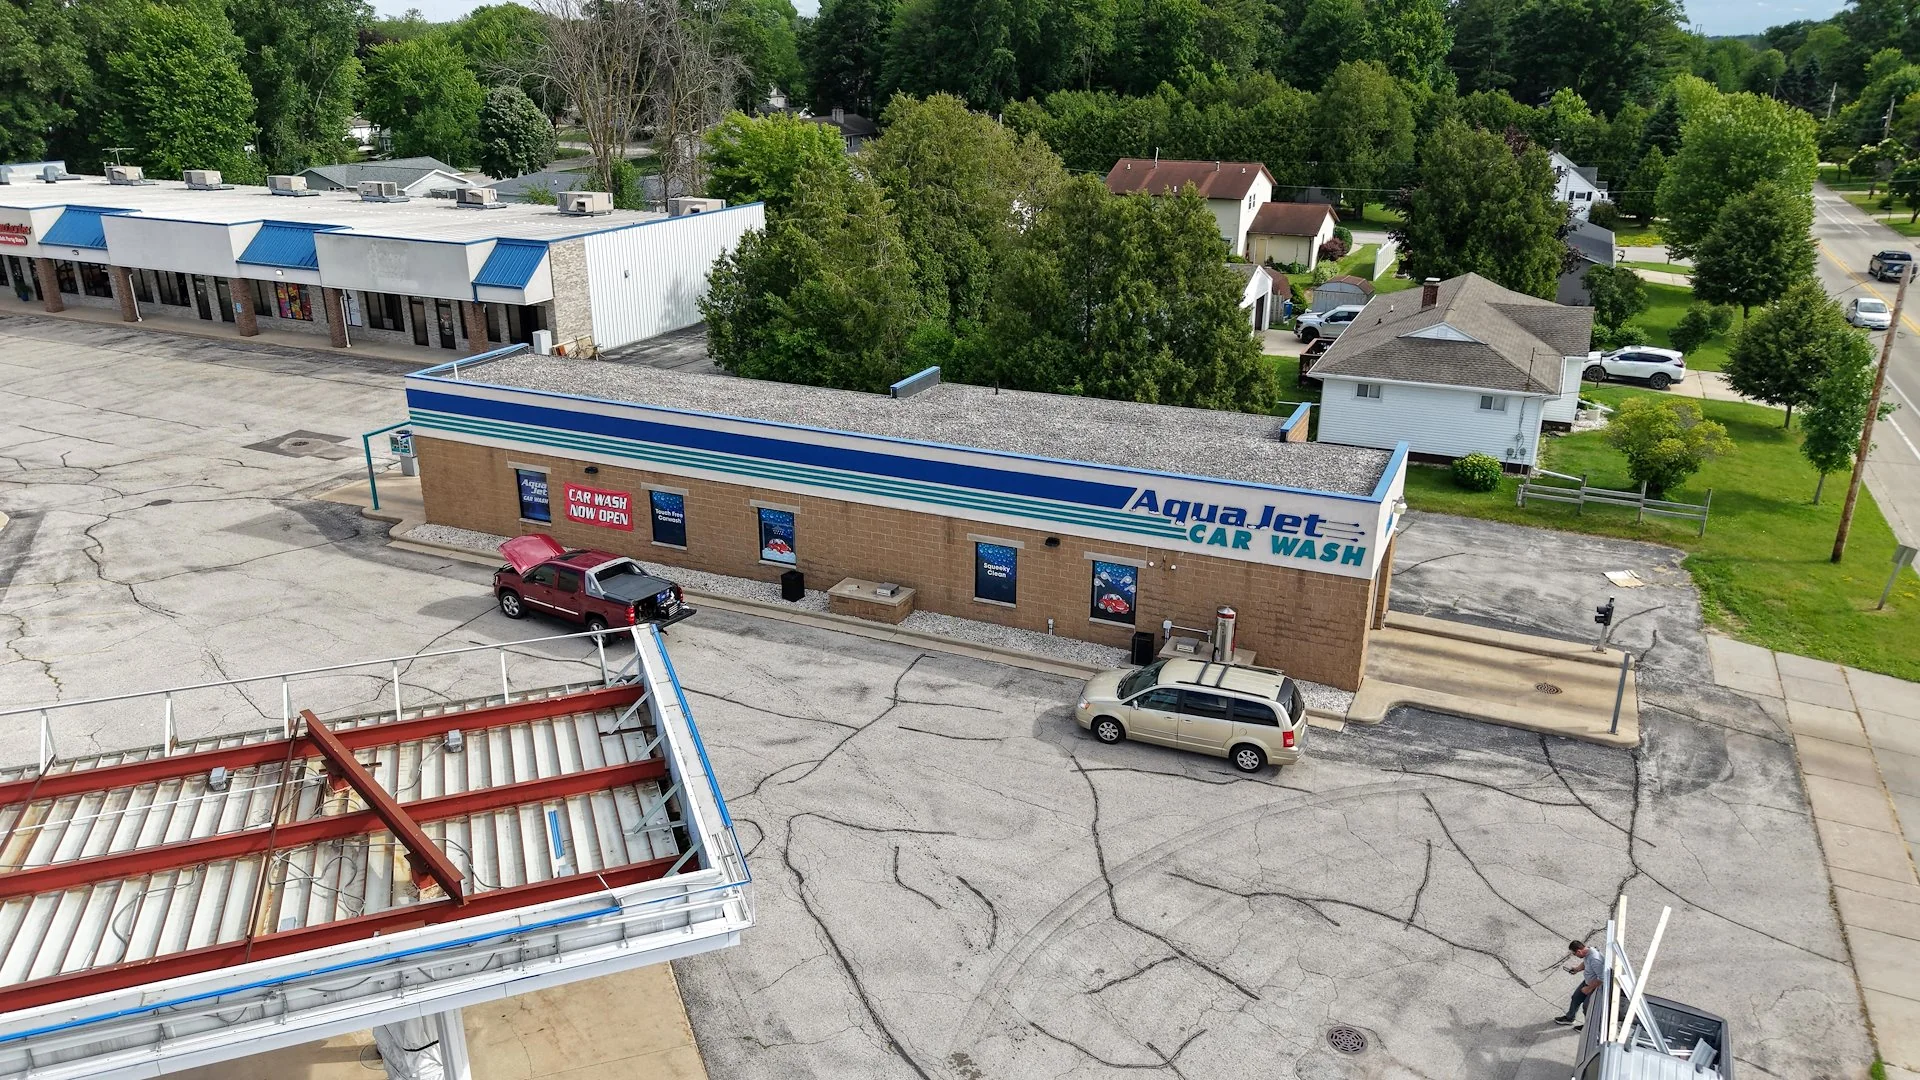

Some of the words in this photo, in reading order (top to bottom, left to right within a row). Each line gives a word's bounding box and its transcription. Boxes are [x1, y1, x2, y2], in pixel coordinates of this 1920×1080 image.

[521, 479, 547, 489] Aqua
[531, 488, 548, 496] Jet
[568, 488, 591, 504] CAR
[594, 493, 627, 510] WASH
[569, 504, 596, 520] NOW
[598, 509, 629, 525] OPEN
[655, 508, 671, 516] Touch
[672, 510, 684, 518] Free
[1189, 524, 1253, 551] CAR
[1271, 535, 1367, 567] WASH
[987, 569, 1007, 578] Clean
